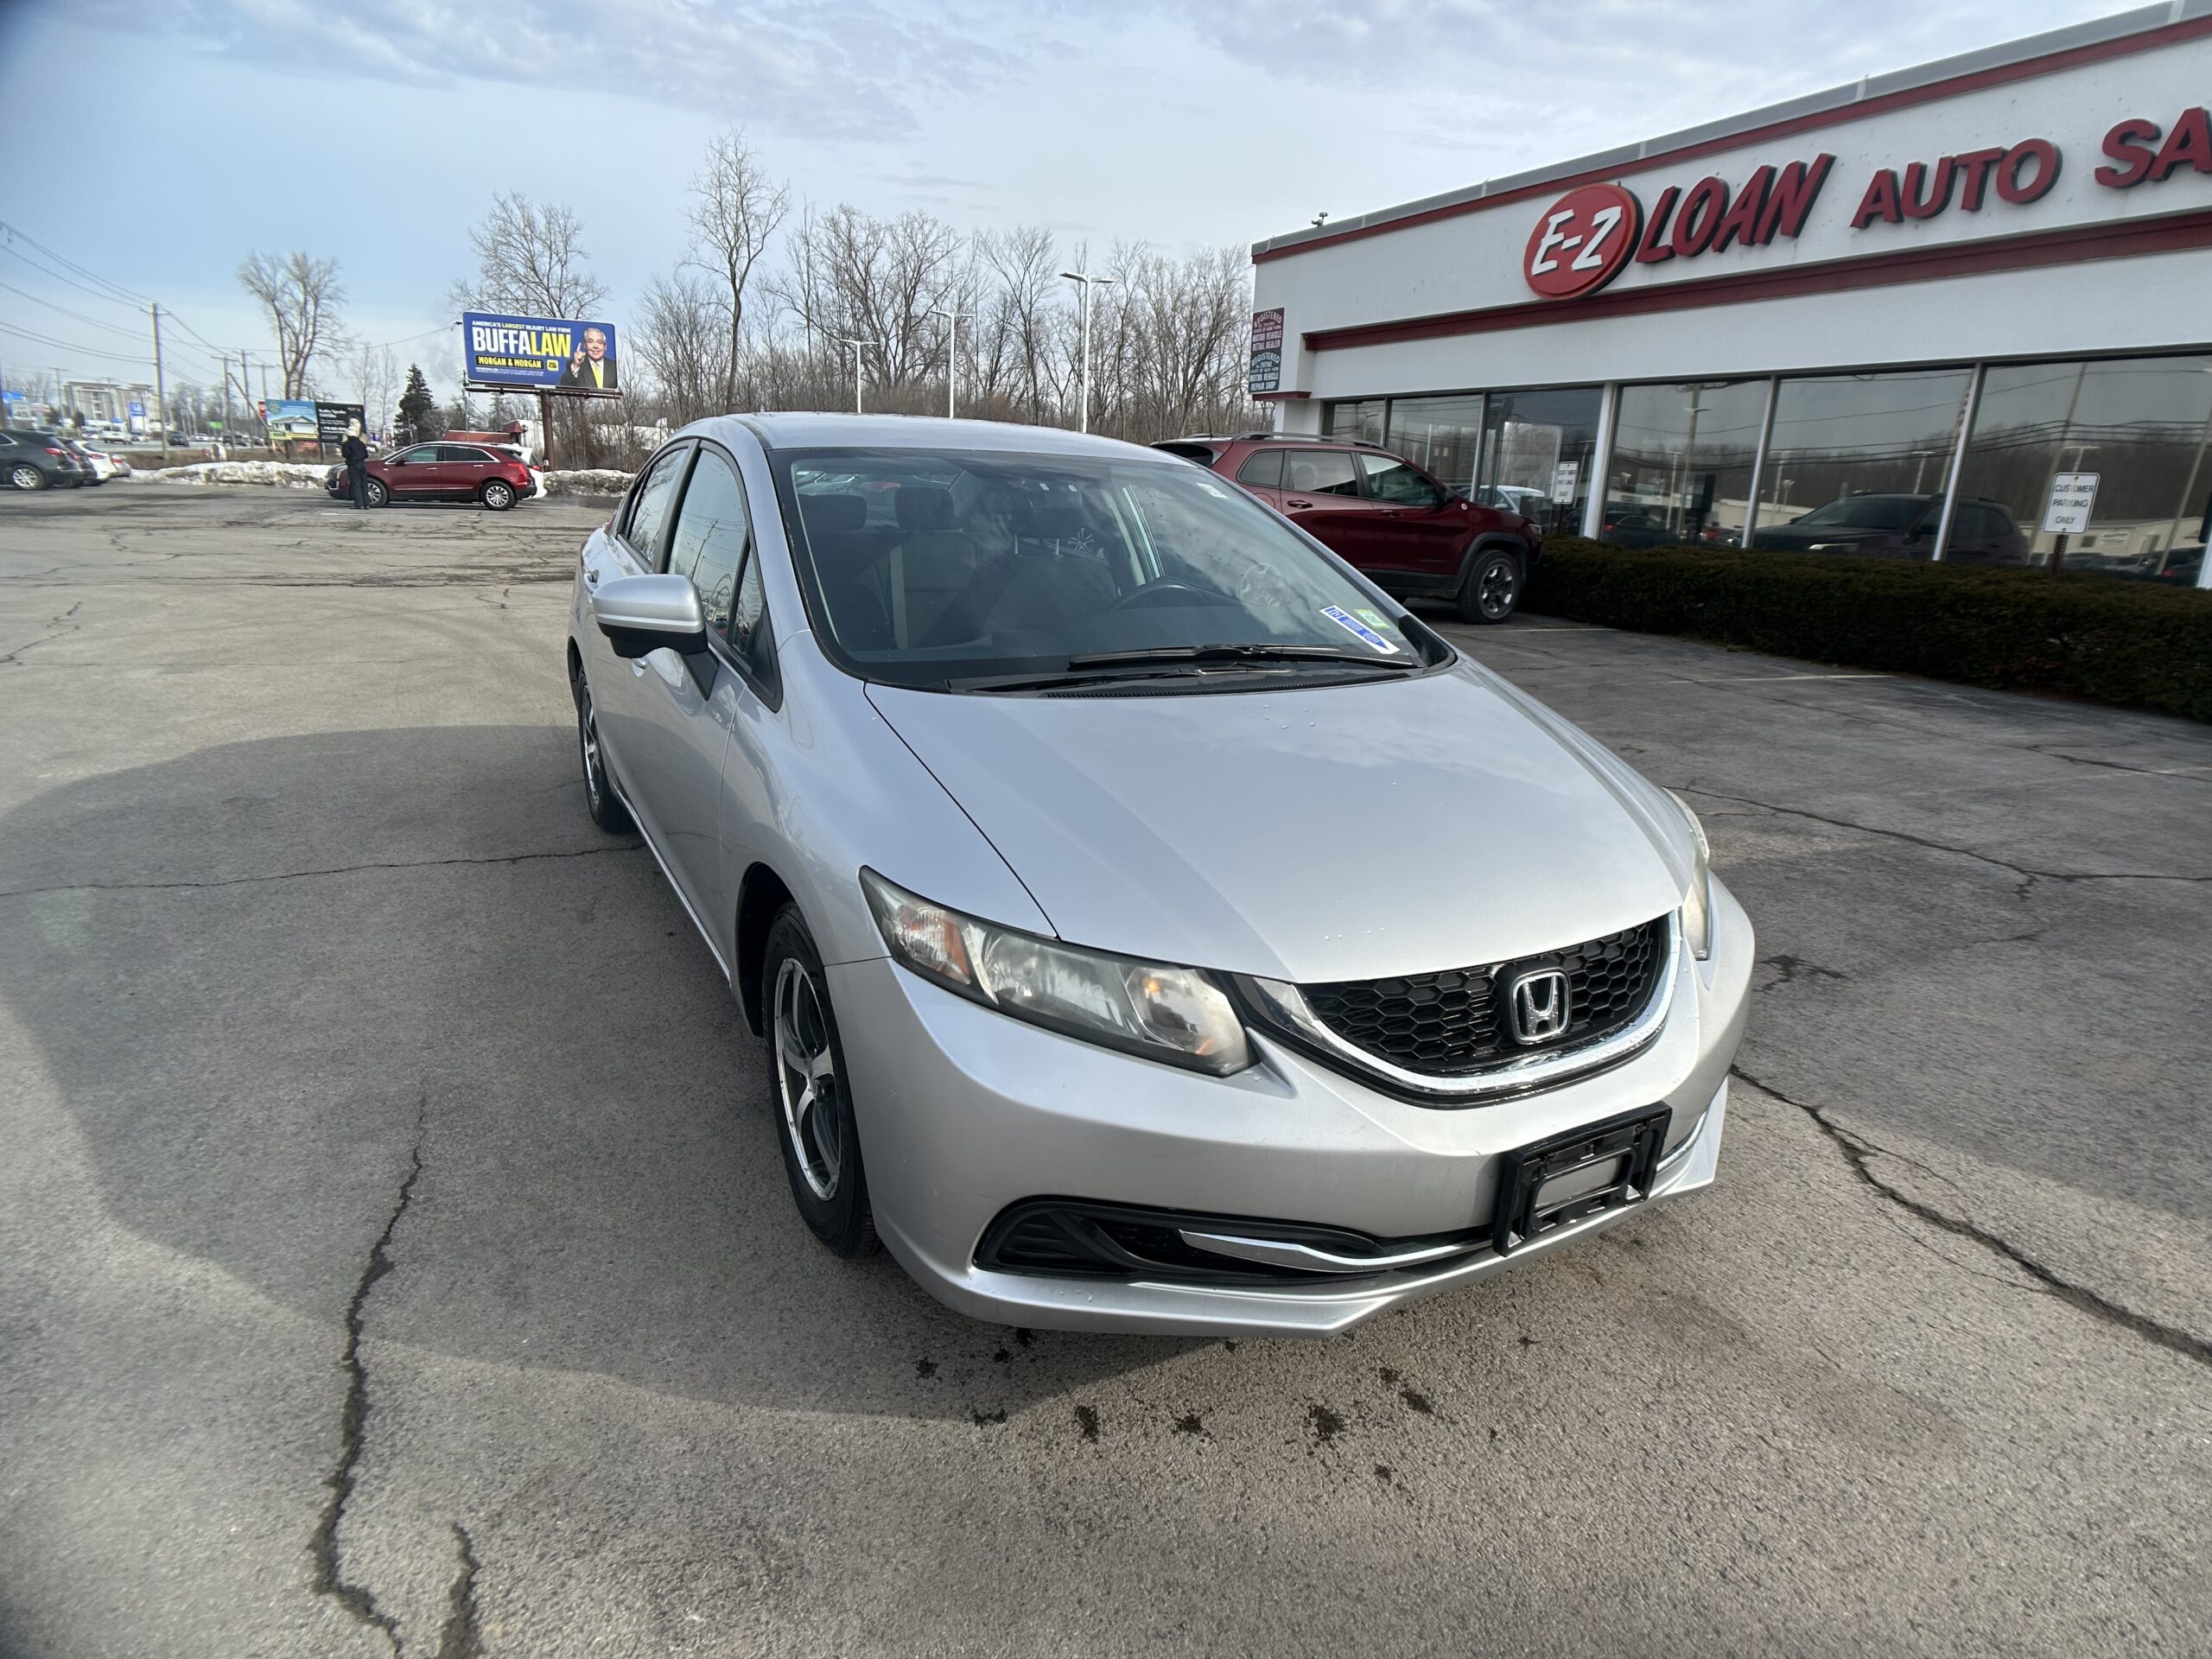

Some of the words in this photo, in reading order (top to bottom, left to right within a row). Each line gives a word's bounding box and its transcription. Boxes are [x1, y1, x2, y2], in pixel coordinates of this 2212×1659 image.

[1531, 206, 1622, 276] E-Z
[1636, 153, 1836, 264] LOAN
[1850, 137, 2063, 229] AUTO
[2094, 105, 2212, 188] SA
[1254, 310, 1282, 328] REGISTERED
[472, 327, 571, 358] BUFFALAW
[478, 356, 507, 366] MORGAN
[507, 358, 513, 367] &
[513, 358, 542, 368] MORGAN
[1251, 352, 1281, 366] REGISTERED
[2055, 484, 2094, 493] CUSTOMER
[2052, 499, 2088, 508] PARKING
[2056, 516, 2075, 524] ONLY
